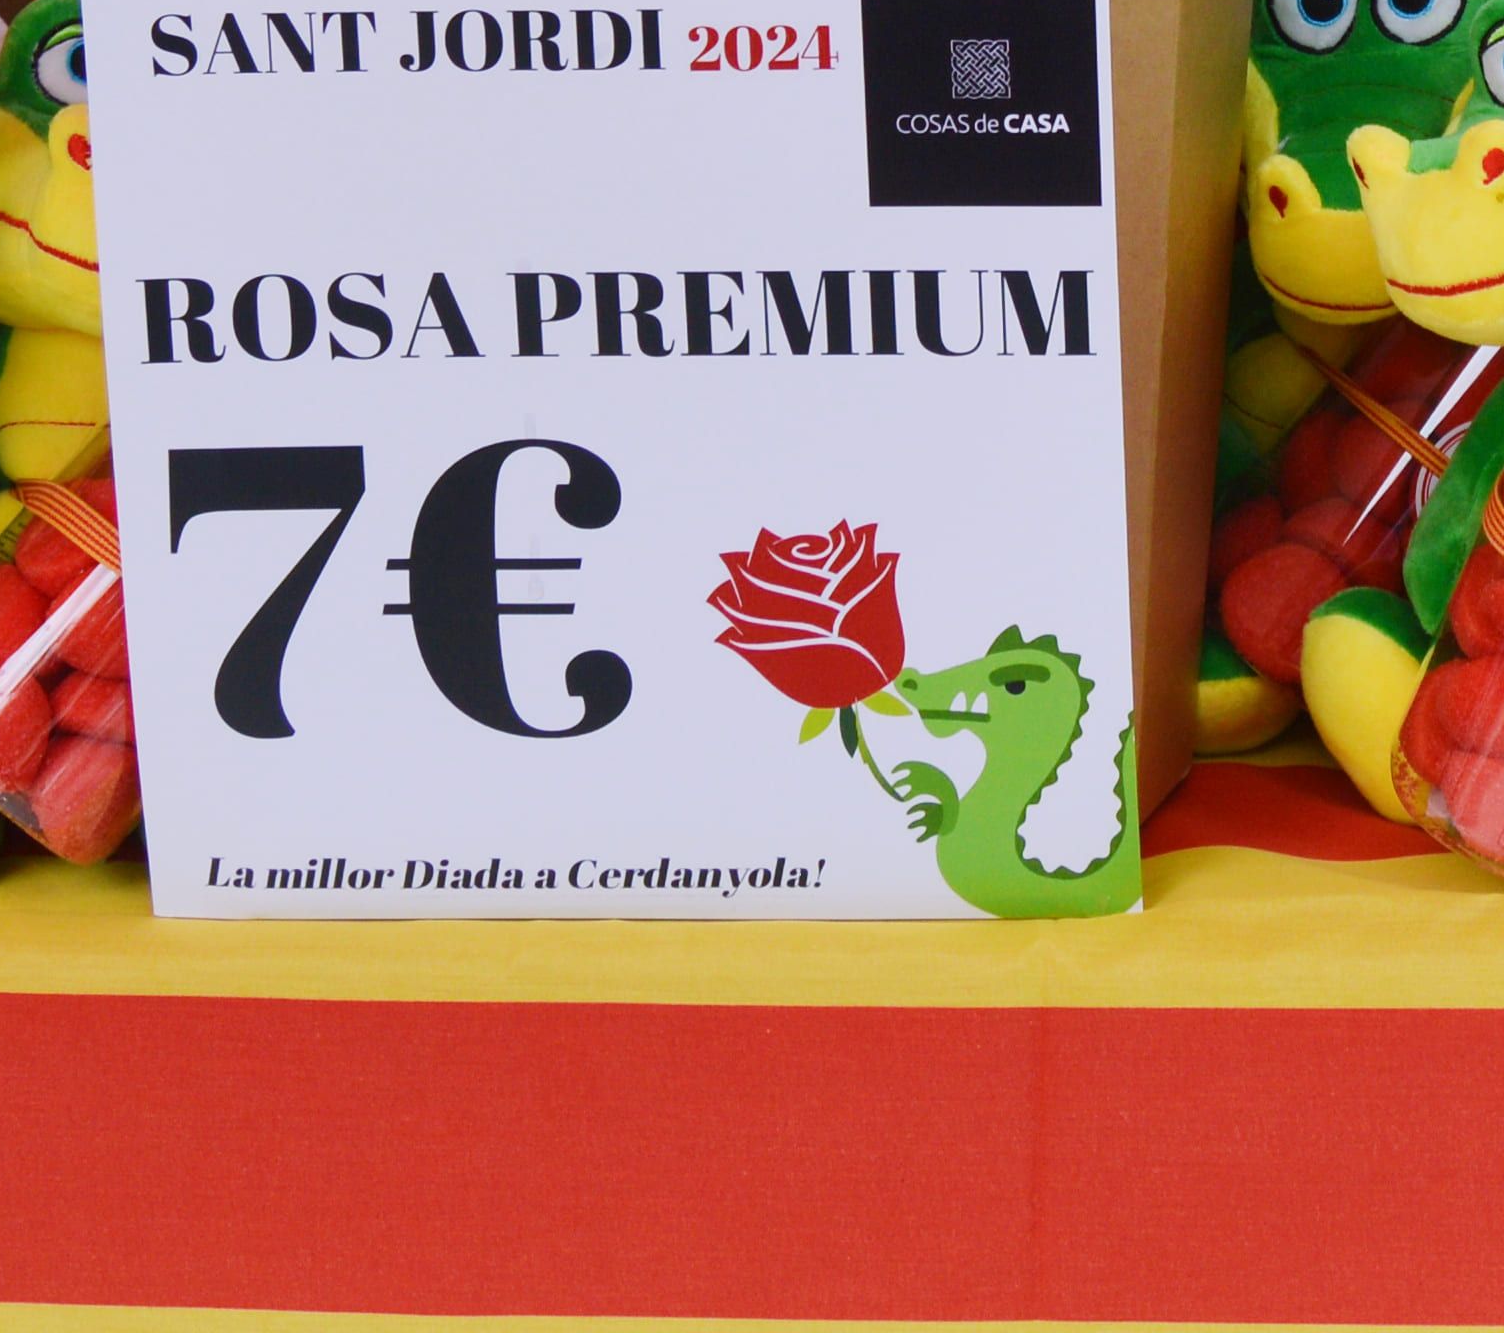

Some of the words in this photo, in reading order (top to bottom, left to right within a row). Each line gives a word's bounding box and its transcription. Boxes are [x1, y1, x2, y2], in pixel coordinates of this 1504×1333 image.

[149, 10, 377, 78] SANT
[398, 7, 666, 75] JORDI
[686, 23, 841, 73] 2024
[895, 113, 971, 137] COSAS
[973, 114, 1000, 136] de
[1002, 113, 1071, 136] CASA
[135, 272, 486, 367] ROSA
[506, 267, 1098, 359] PREMIUM
[166, 437, 635, 742] 7€
[205, 856, 256, 893] La
[263, 857, 395, 893] millor
[400, 857, 526, 893] Diada
[533, 866, 559, 891] a
[565, 856, 826, 899] Cerdanyola!
